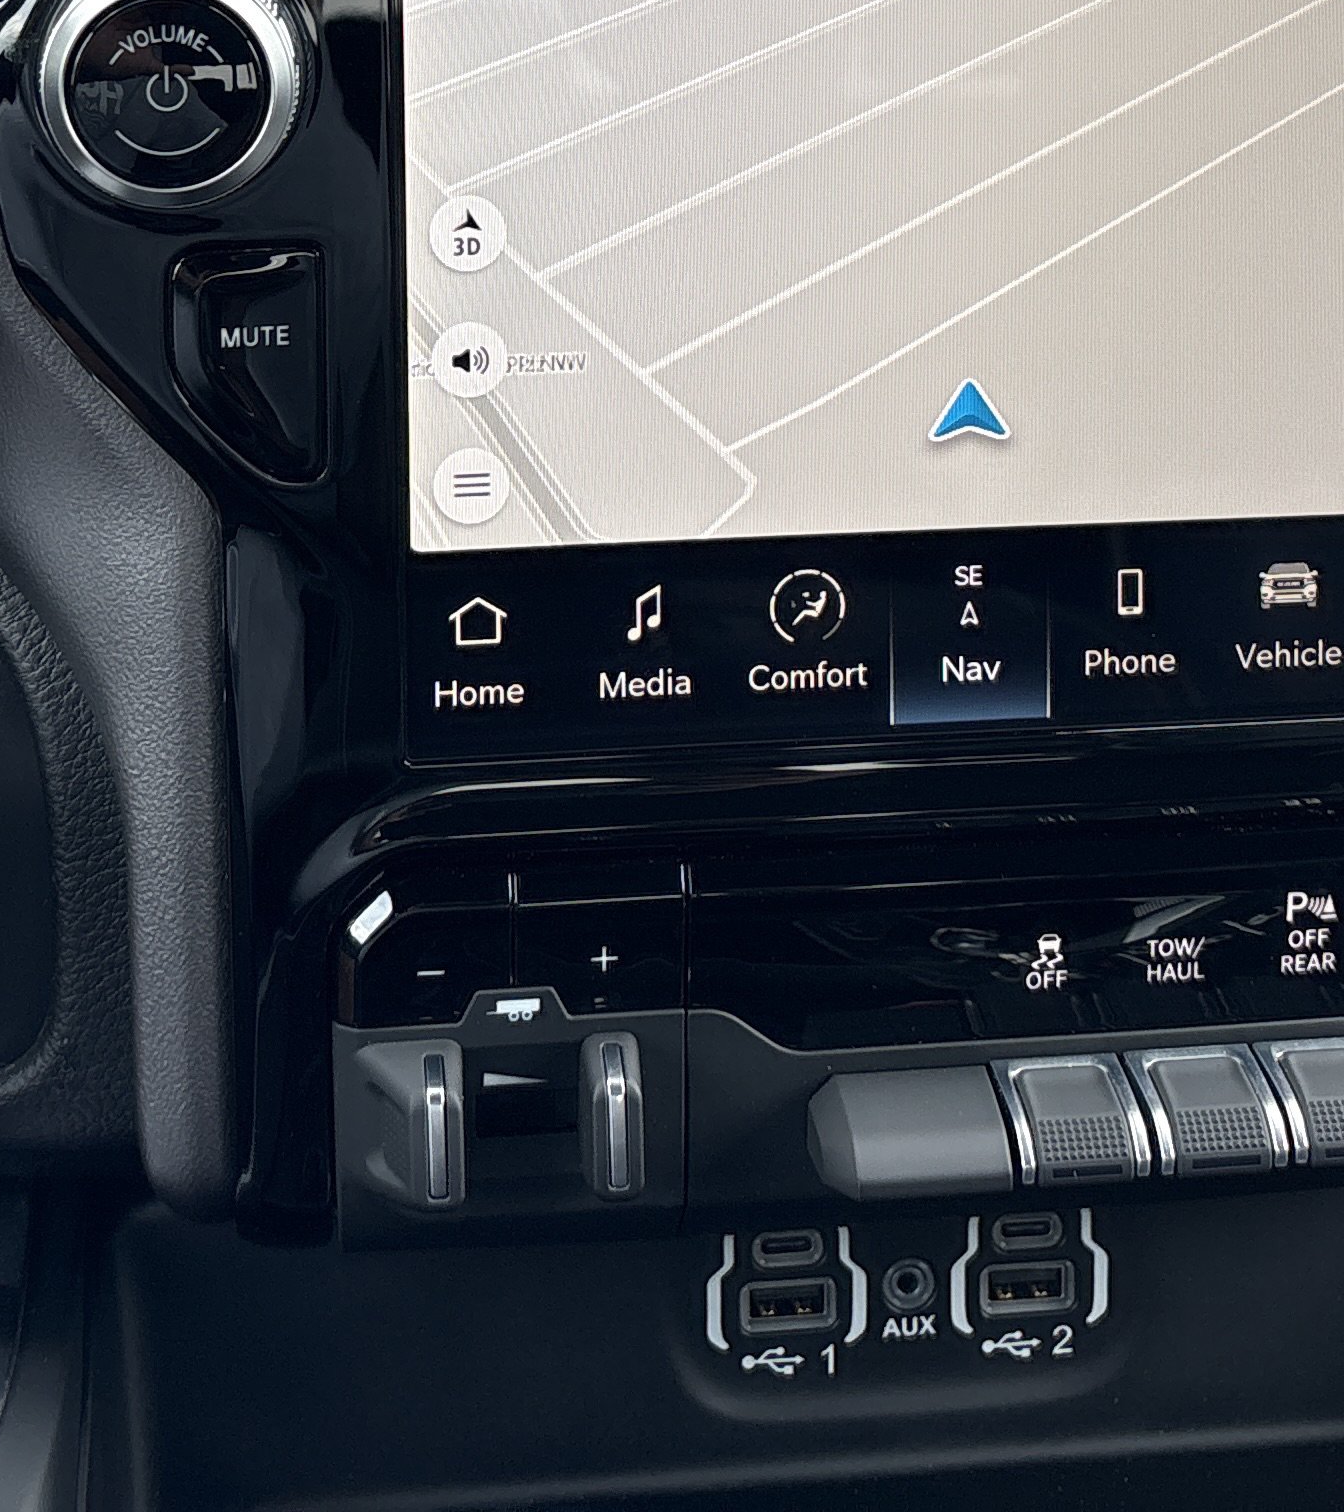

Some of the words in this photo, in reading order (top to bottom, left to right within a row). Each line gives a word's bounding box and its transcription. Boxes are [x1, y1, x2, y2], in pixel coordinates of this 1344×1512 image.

[119, 24, 210, 55] VOLUME
[453, 237, 481, 256] 3D
[220, 325, 291, 349] MUTE
[954, 565, 983, 586] SE
[1084, 648, 1176, 676] Phone
[1236, 638, 1343, 669] Vehicle
[748, 662, 868, 691] Comfort
[941, 656, 1001, 684] Nav
[434, 680, 525, 709] Home
[599, 670, 692, 699] Media
[1146, 936, 1206, 960] TOW/
[1288, 928, 1330, 950] OFF
[1146, 960, 1205, 983] HAUL
[1281, 951, 1337, 975] REAR
[1025, 969, 1068, 990] OFF
[882, 1314, 937, 1339] AUX
[1051, 1325, 1074, 1356] 2
[820, 1343, 836, 1376] 1
